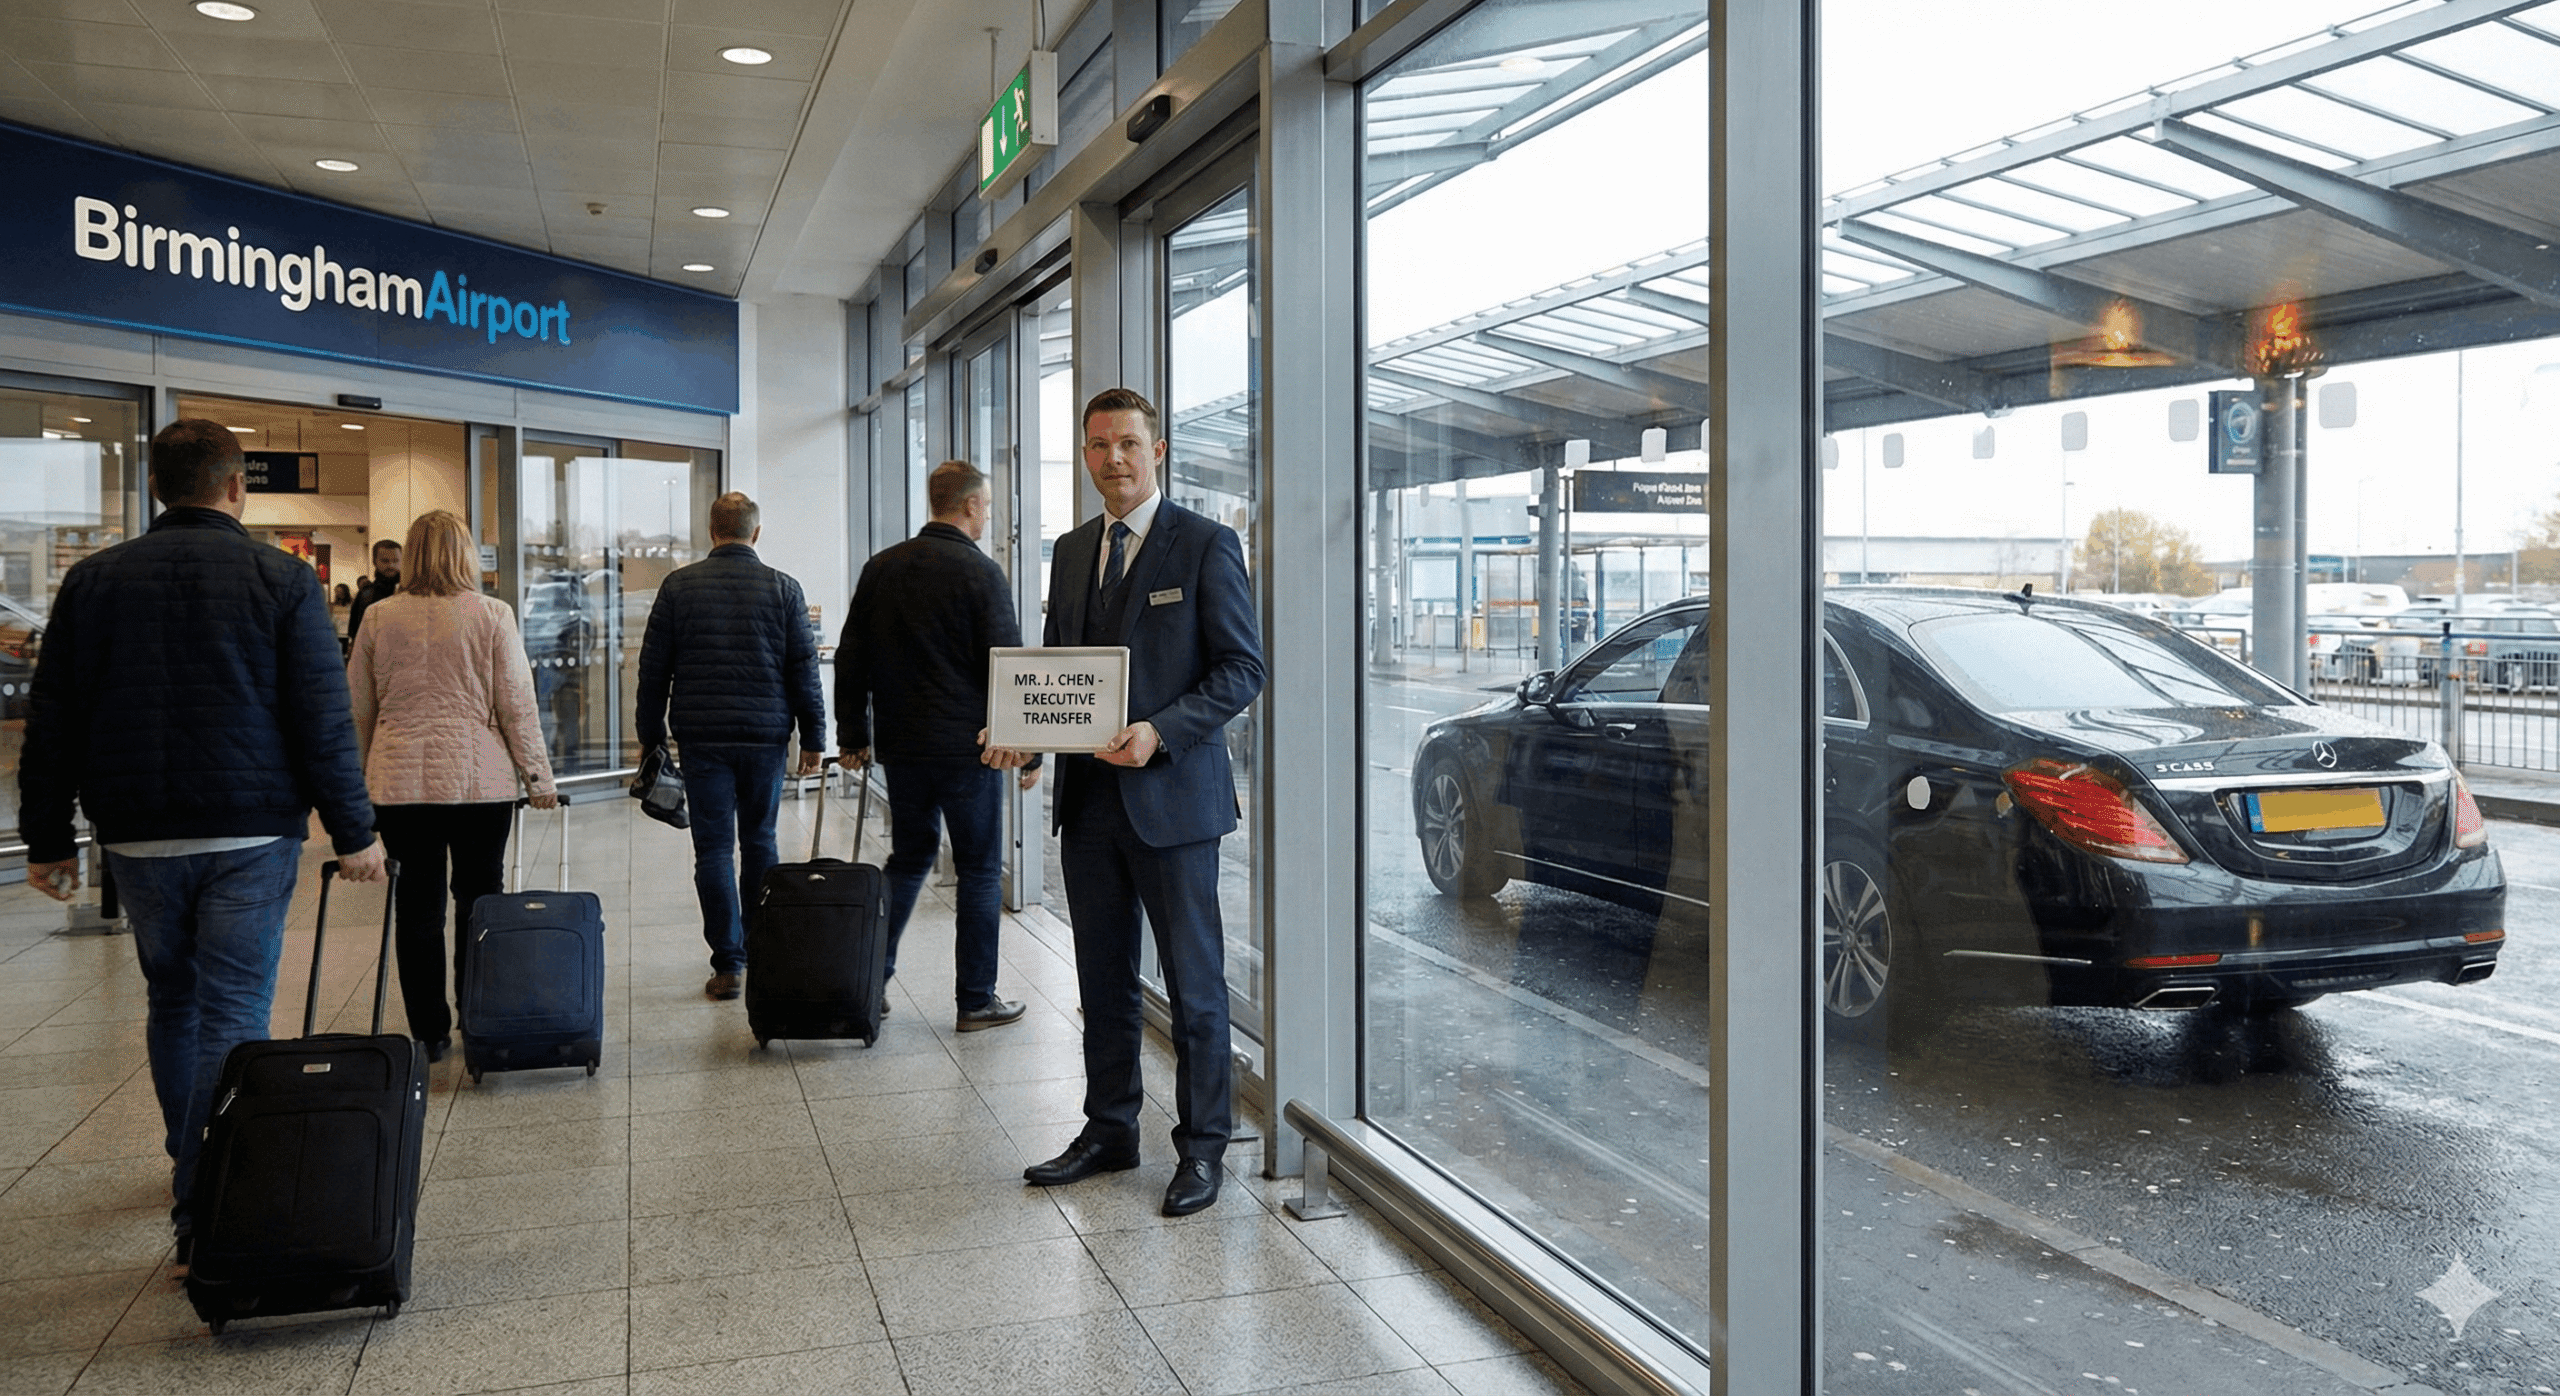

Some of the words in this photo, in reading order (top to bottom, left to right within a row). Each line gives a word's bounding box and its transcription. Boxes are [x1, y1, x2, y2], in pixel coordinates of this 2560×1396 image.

[1014, 674, 1041, 686] MR.
[1044, 674, 1054, 686] J.
[1058, 674, 1094, 686] CHEN
[1024, 693, 1095, 705] EXECUTIVE
[1023, 712, 1091, 724] TRANSFER
